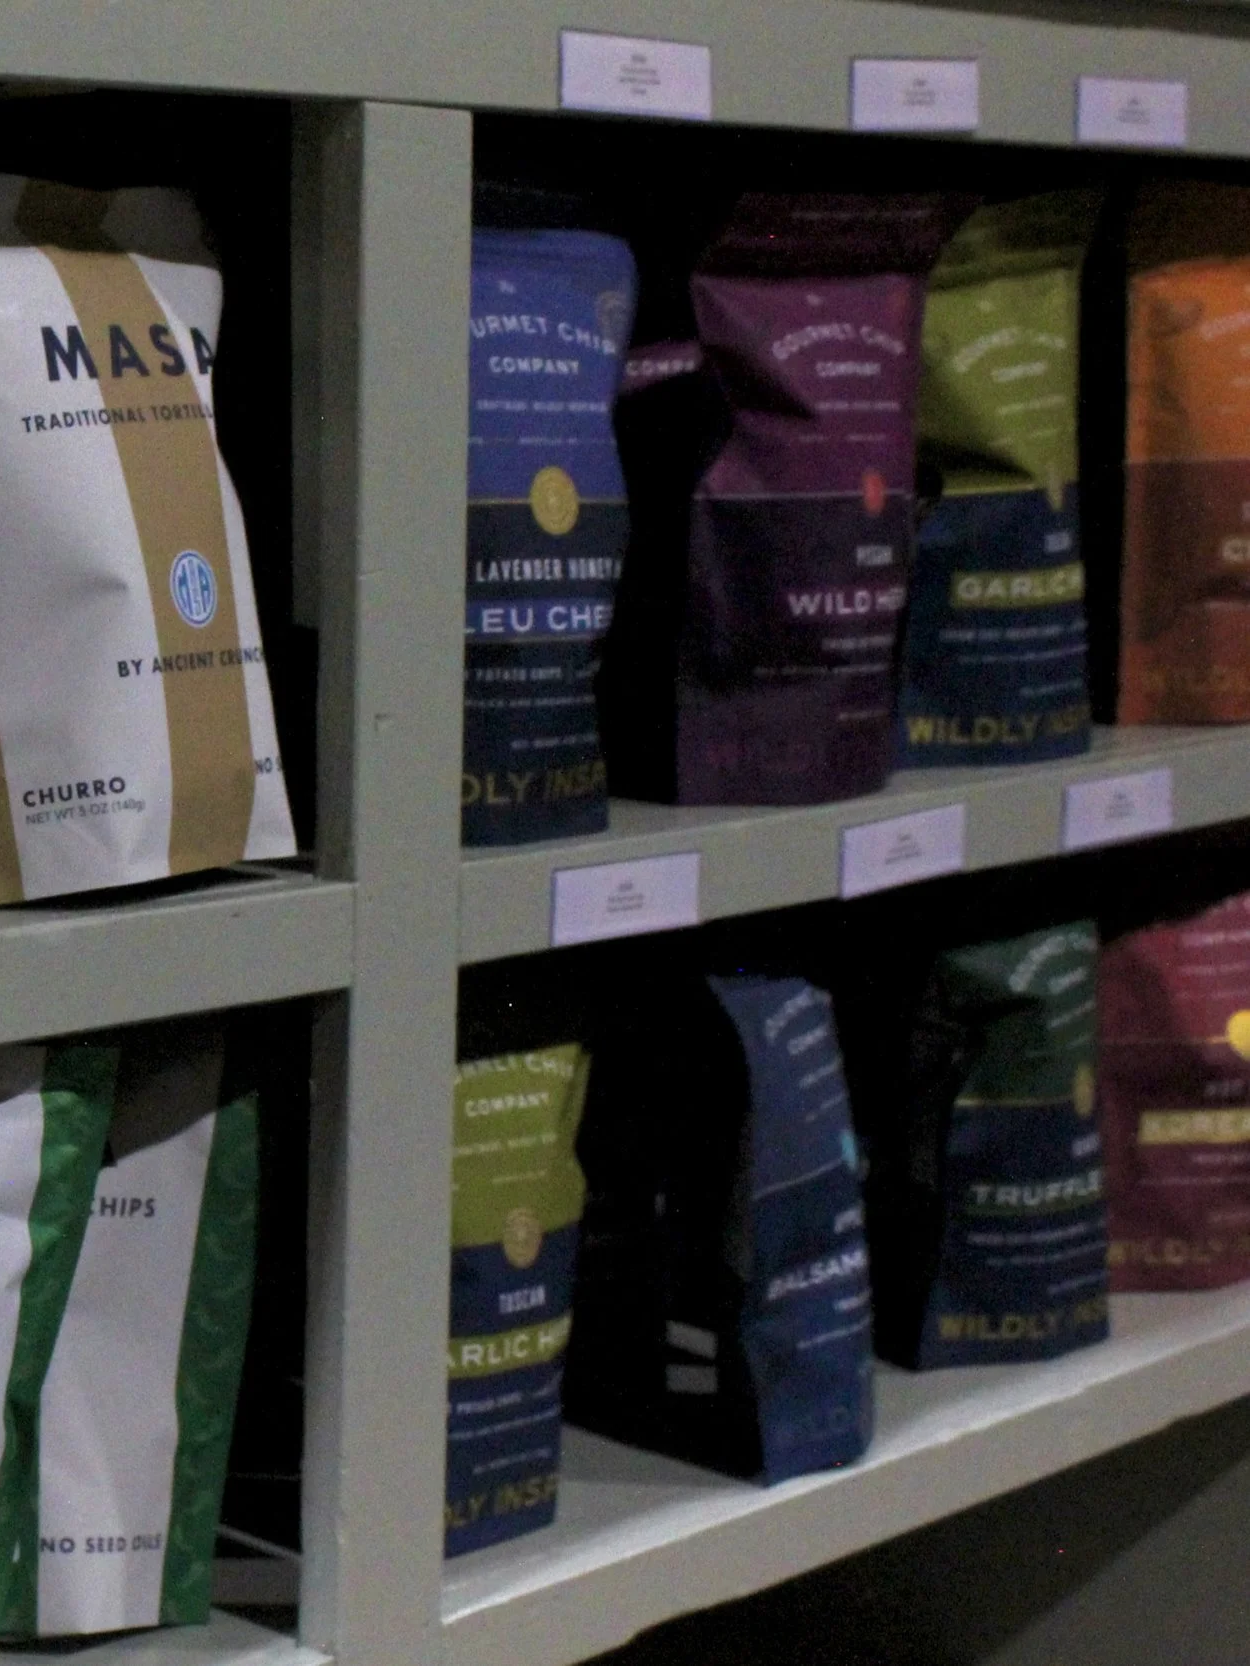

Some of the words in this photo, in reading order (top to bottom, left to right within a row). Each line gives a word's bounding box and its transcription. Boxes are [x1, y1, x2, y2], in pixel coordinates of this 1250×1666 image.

[22, 407, 147, 432] TRADITIONAL
[464, 608, 534, 634] EU
[117, 659, 143, 678] BY
[152, 651, 213, 674] ANCIENT
[23, 776, 126, 808] CHURRO
[25, 811, 50, 825] NET
[90, 803, 109, 816] OZ
[40, 1535, 75, 1553] NO
[85, 1535, 127, 1553] SEED
